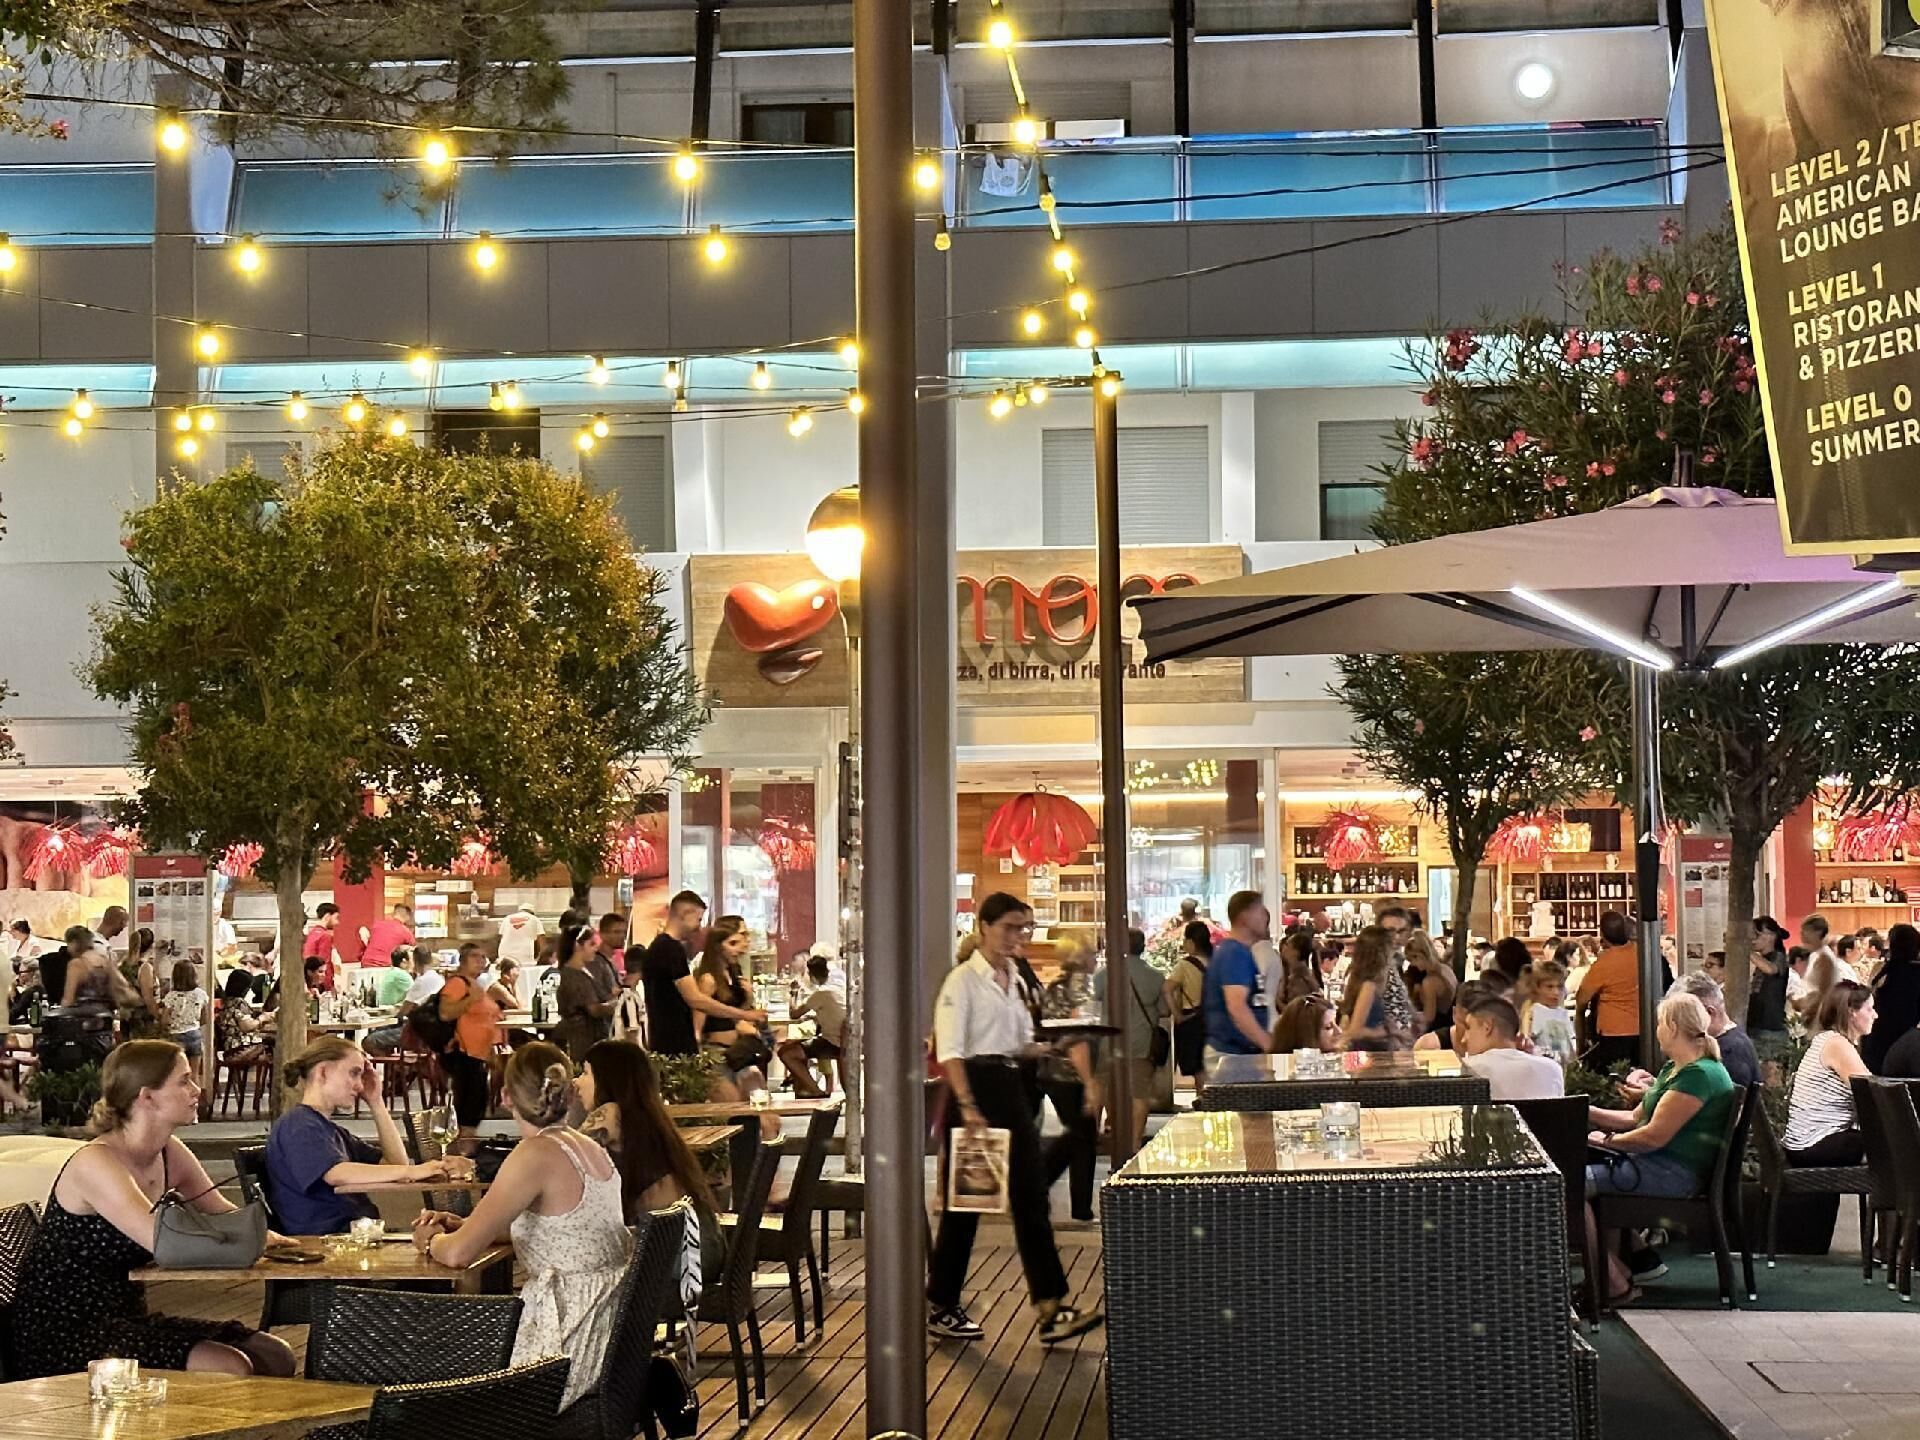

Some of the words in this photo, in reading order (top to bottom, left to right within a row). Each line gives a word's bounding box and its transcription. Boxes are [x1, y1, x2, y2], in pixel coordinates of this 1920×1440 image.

[1771, 149, 1849, 198] LEVEL
[1776, 160, 1912, 232] AMERICAN
[1780, 206, 1884, 264] LOUNGE
[1788, 270, 1866, 316] LEVEL
[1871, 262, 1884, 289] 1
[1793, 287, 1920, 349] RISTORAN
[1799, 354, 1815, 381] &
[1822, 323, 1920, 375] PIZZERI
[1806, 391, 1886, 434] LEVEL
[1810, 418, 1920, 466] SUMMER
[957, 666, 983, 681] za,
[988, 662, 1004, 680] di
[1009, 661, 1055, 682] birra,
[1060, 661, 1075, 680] di
